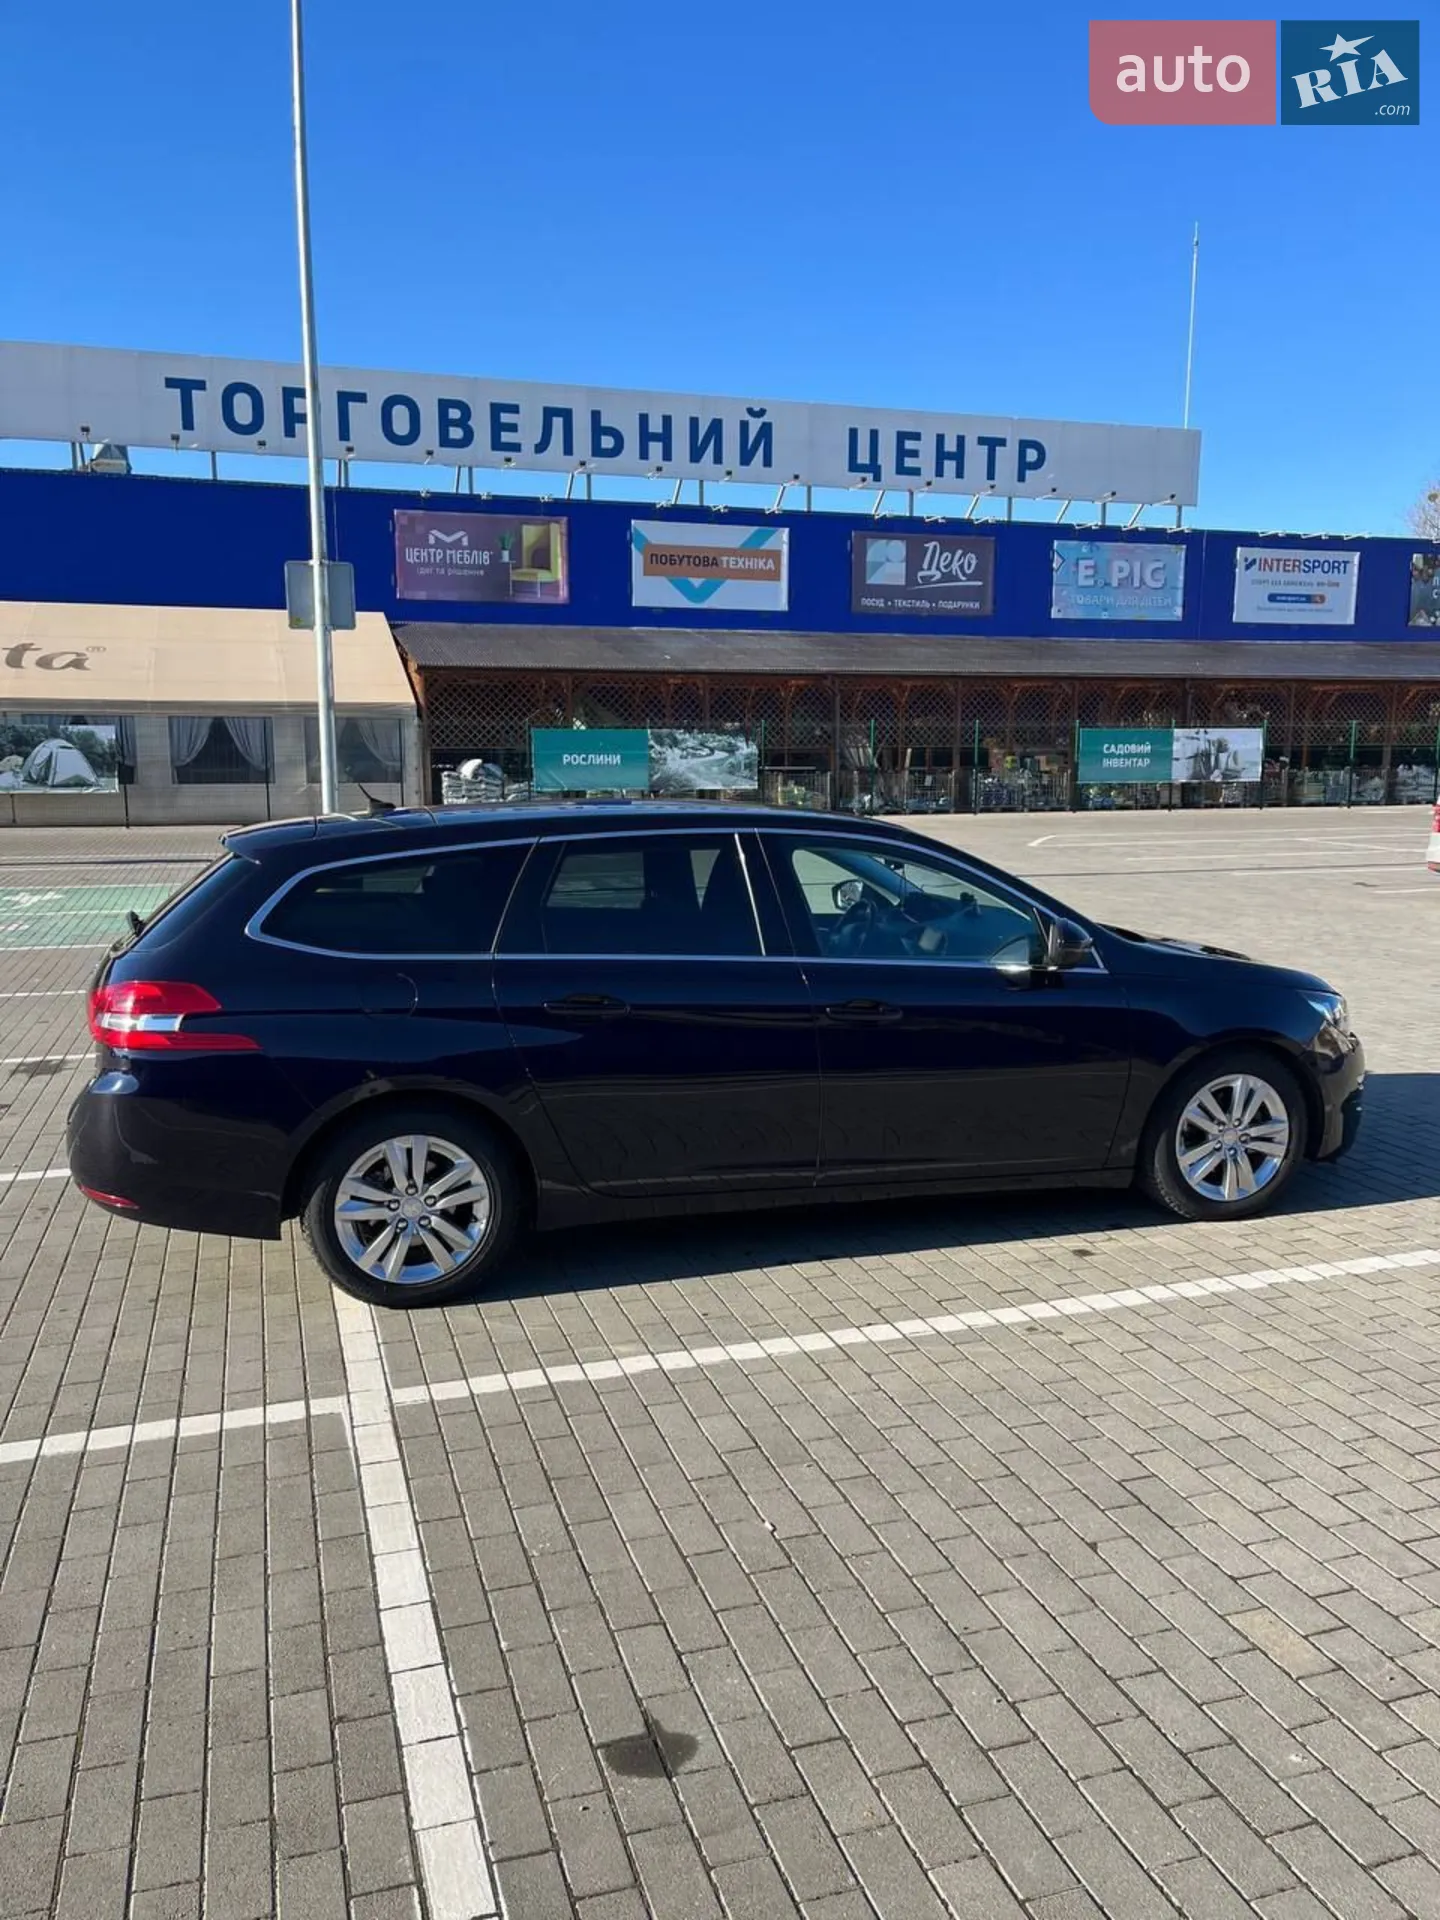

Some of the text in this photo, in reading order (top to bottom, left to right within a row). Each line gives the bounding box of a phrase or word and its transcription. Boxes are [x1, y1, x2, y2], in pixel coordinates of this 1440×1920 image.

[164, 376, 1046, 482] ТОРГОВЕЛЬНИЙ ЦЕНТР
[405, 547, 443, 564] ЦЕНТР
[650, 553, 775, 570] ПОБУТОВА ТЕХНІКА
[917, 541, 977, 583] Деко
[1111, 559, 1166, 588] PIC
[1258, 557, 1350, 575] INTERSPORT
[1103, 741, 1151, 756] САДОВИЙ
[562, 753, 621, 766] РОСЛИНИ
[1102, 757, 1150, 769] ІНВЕНТАР
